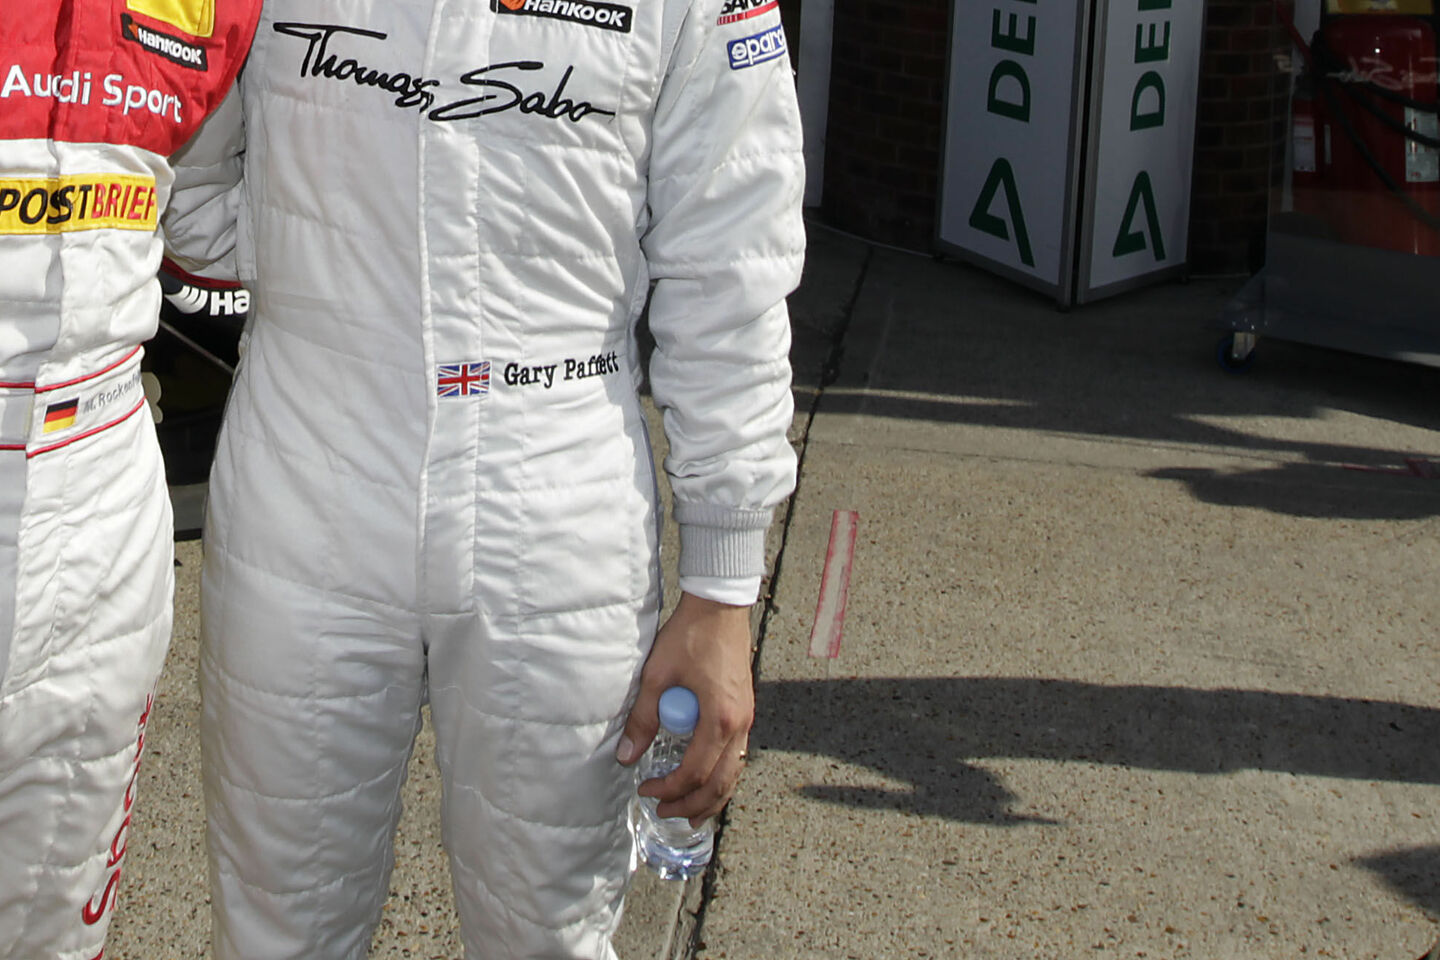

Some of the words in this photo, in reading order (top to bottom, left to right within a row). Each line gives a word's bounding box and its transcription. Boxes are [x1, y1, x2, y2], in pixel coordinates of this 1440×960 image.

[0, 64, 92, 105] Audi
[102, 74, 182, 123] Sport
[273, 22, 440, 113] Thomas
[428, 61, 616, 122] Sabo
[504, 362, 558, 389] Gary
[563, 351, 619, 381] Paffett
